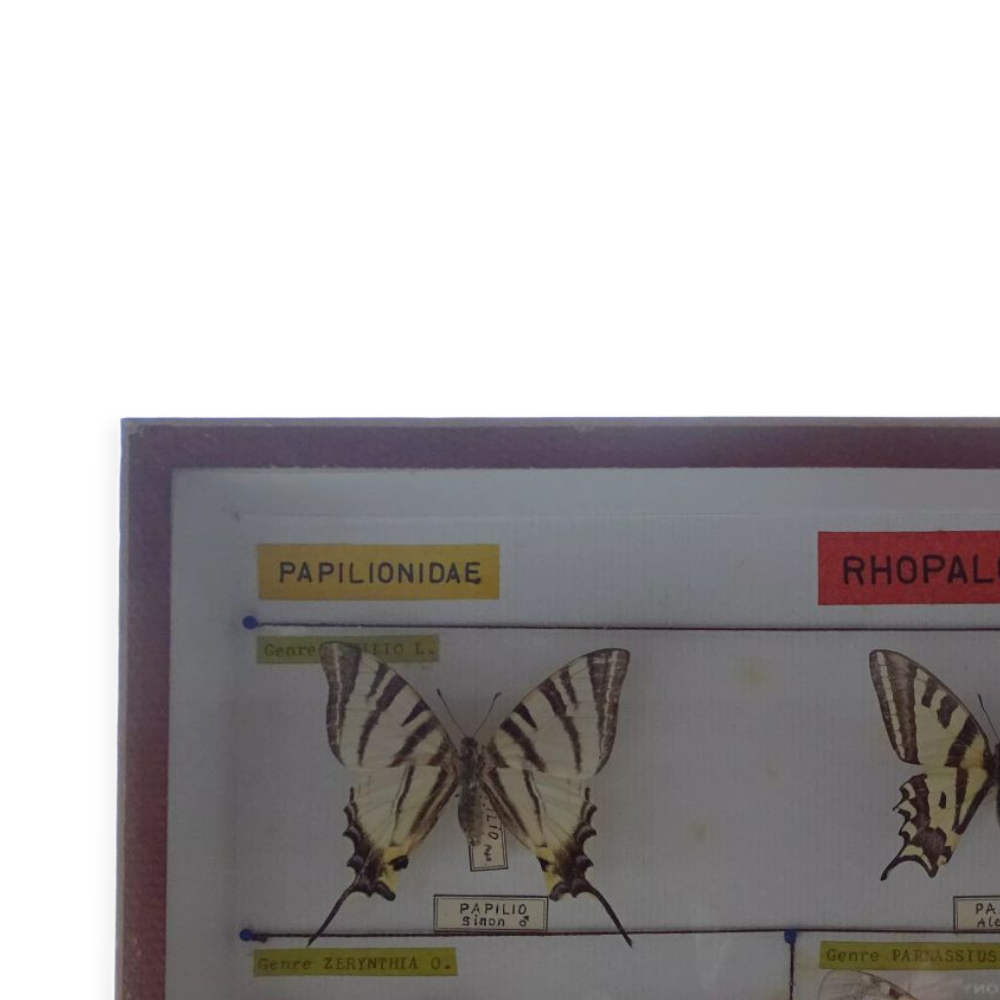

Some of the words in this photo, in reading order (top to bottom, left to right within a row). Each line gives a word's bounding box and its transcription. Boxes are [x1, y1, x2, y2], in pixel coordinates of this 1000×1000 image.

[279, 561, 482, 584] PAPILIONIDAE
[264, 643, 315, 657] Genre
[460, 902, 527, 915] PAPILIO
[257, 957, 312, 970] Genre
[323, 956, 419, 970] ZERYNTHIA
[826, 950, 879, 963] Genre
[892, 950, 997, 963] PARNASSIUS
